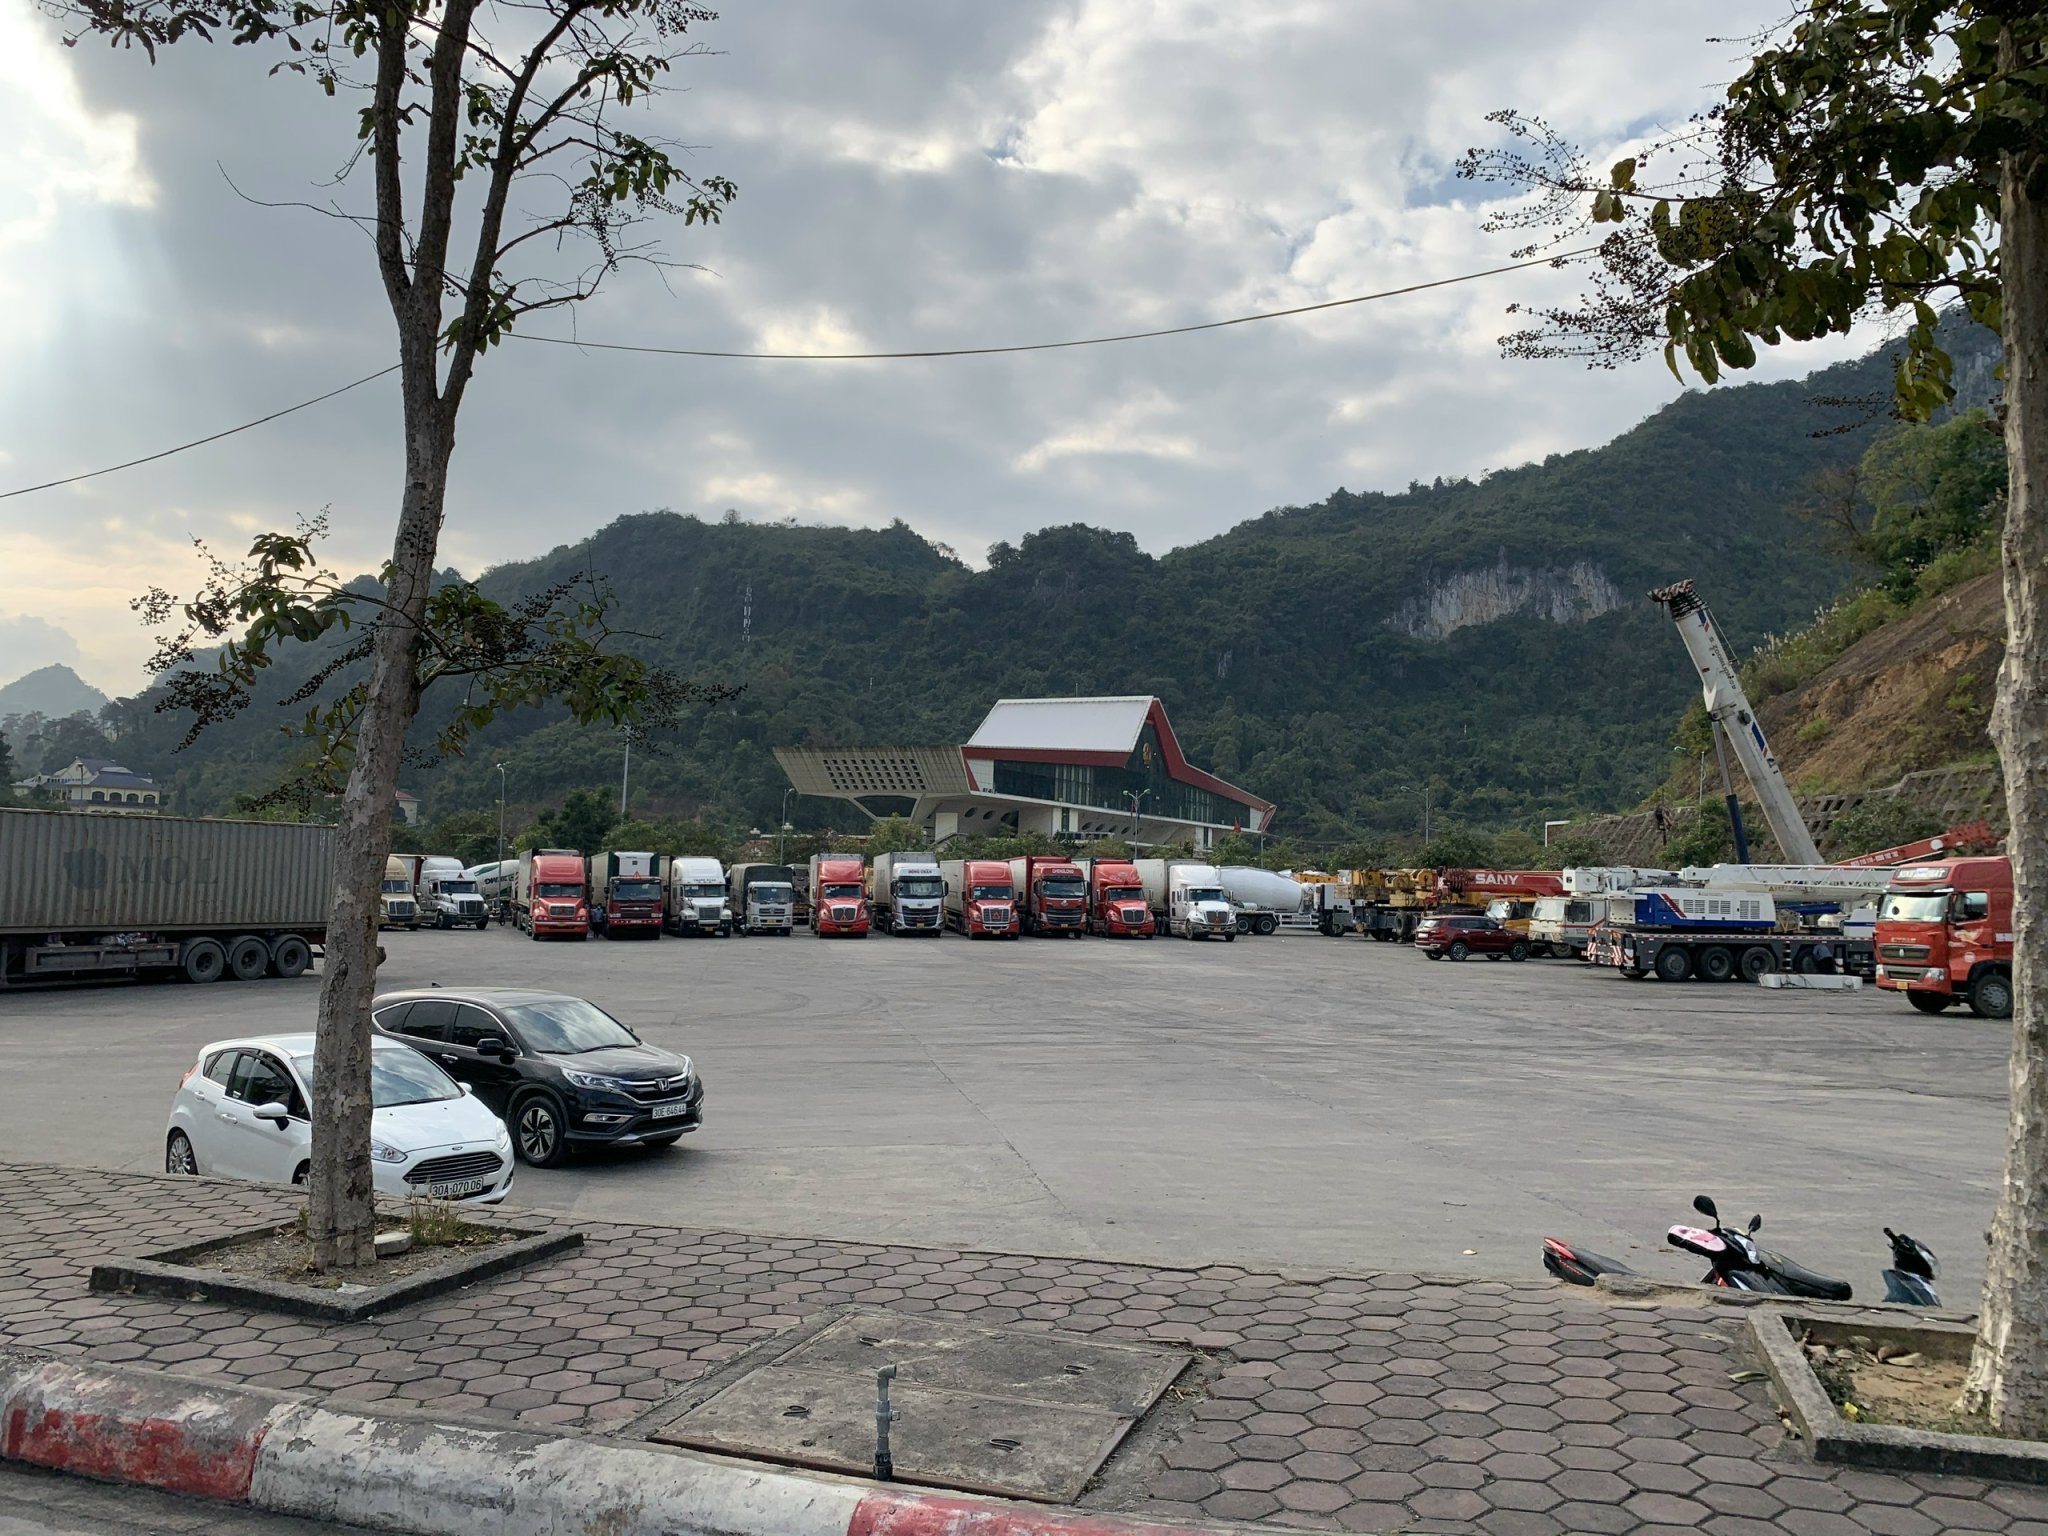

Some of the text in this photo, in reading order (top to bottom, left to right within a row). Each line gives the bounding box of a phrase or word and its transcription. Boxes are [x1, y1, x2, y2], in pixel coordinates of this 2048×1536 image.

[119, 855, 219, 886] MOL
[1475, 873, 1519, 885] SANY
[432, 1179, 483, 1197] 30A-070.06
